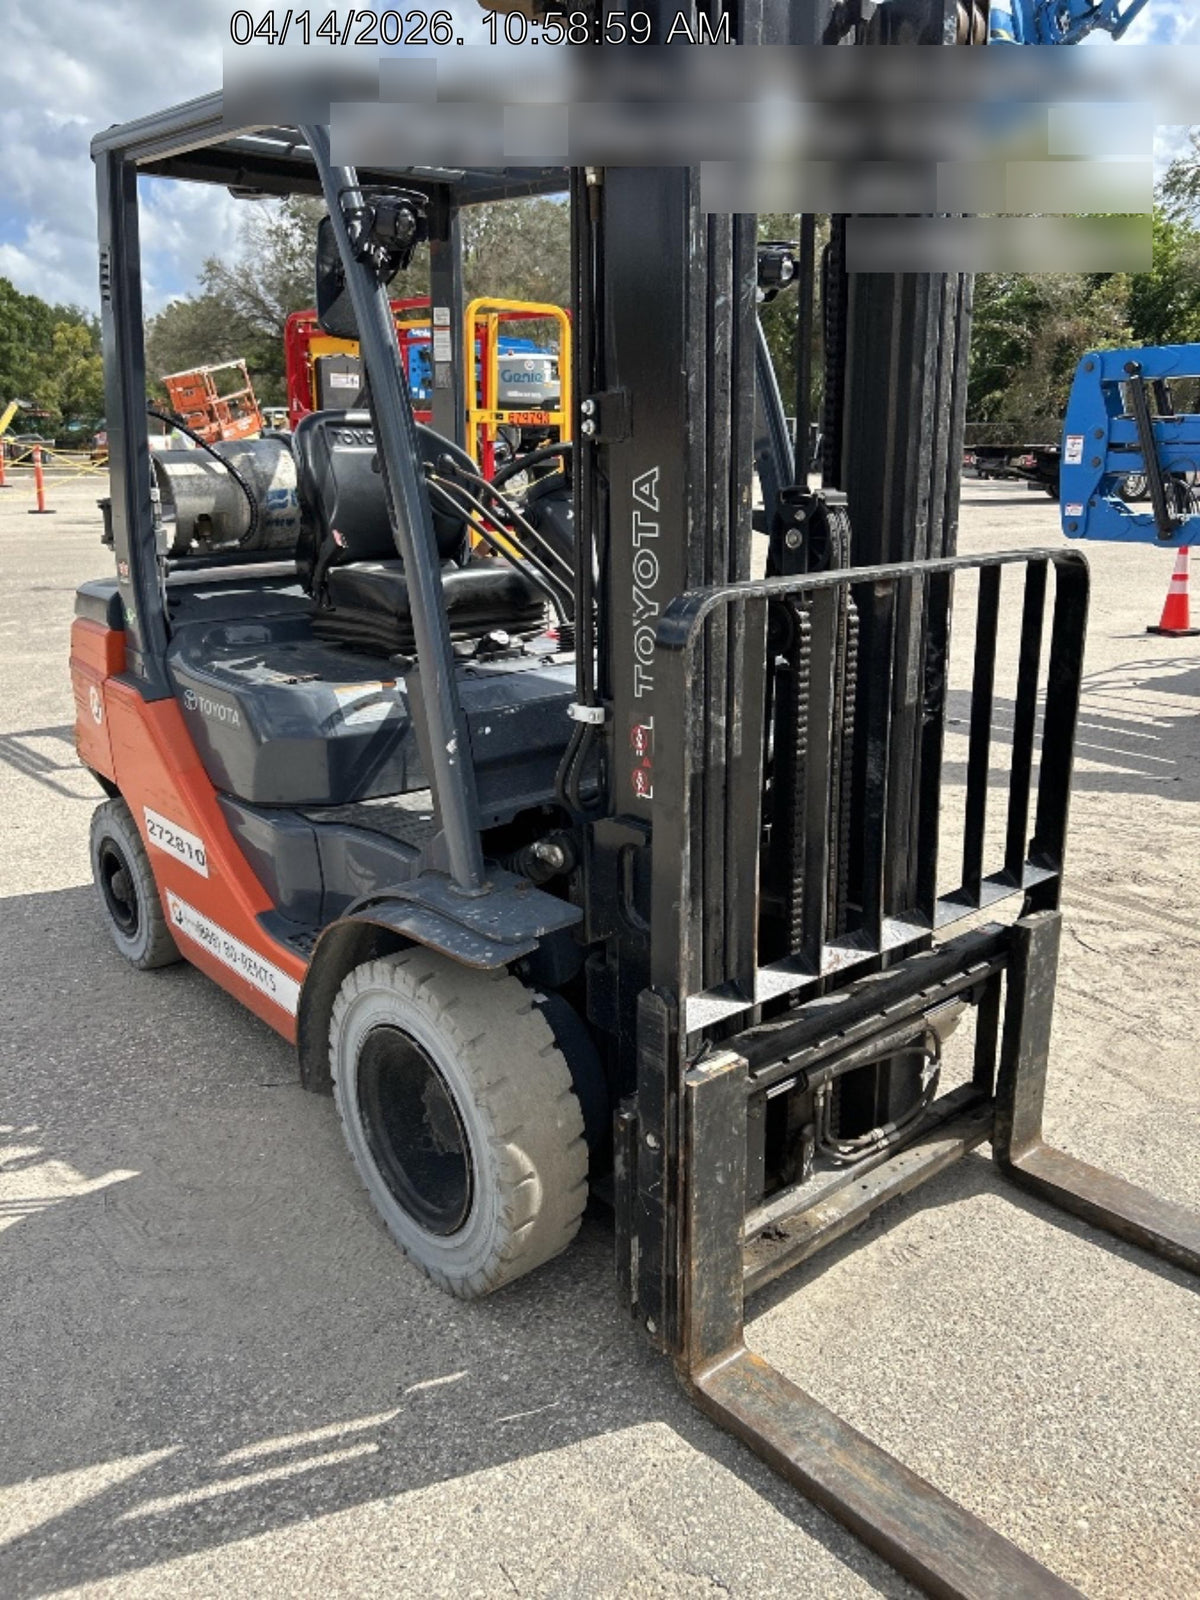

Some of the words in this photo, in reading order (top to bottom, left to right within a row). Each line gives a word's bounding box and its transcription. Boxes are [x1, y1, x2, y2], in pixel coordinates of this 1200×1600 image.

[500, 368, 543, 383] Genie
[330, 428, 376, 445] TOYO
[632, 465, 660, 698] TOYOTA
[198, 696, 241, 727] TOYOTA
[146, 818, 206, 867] 272810
